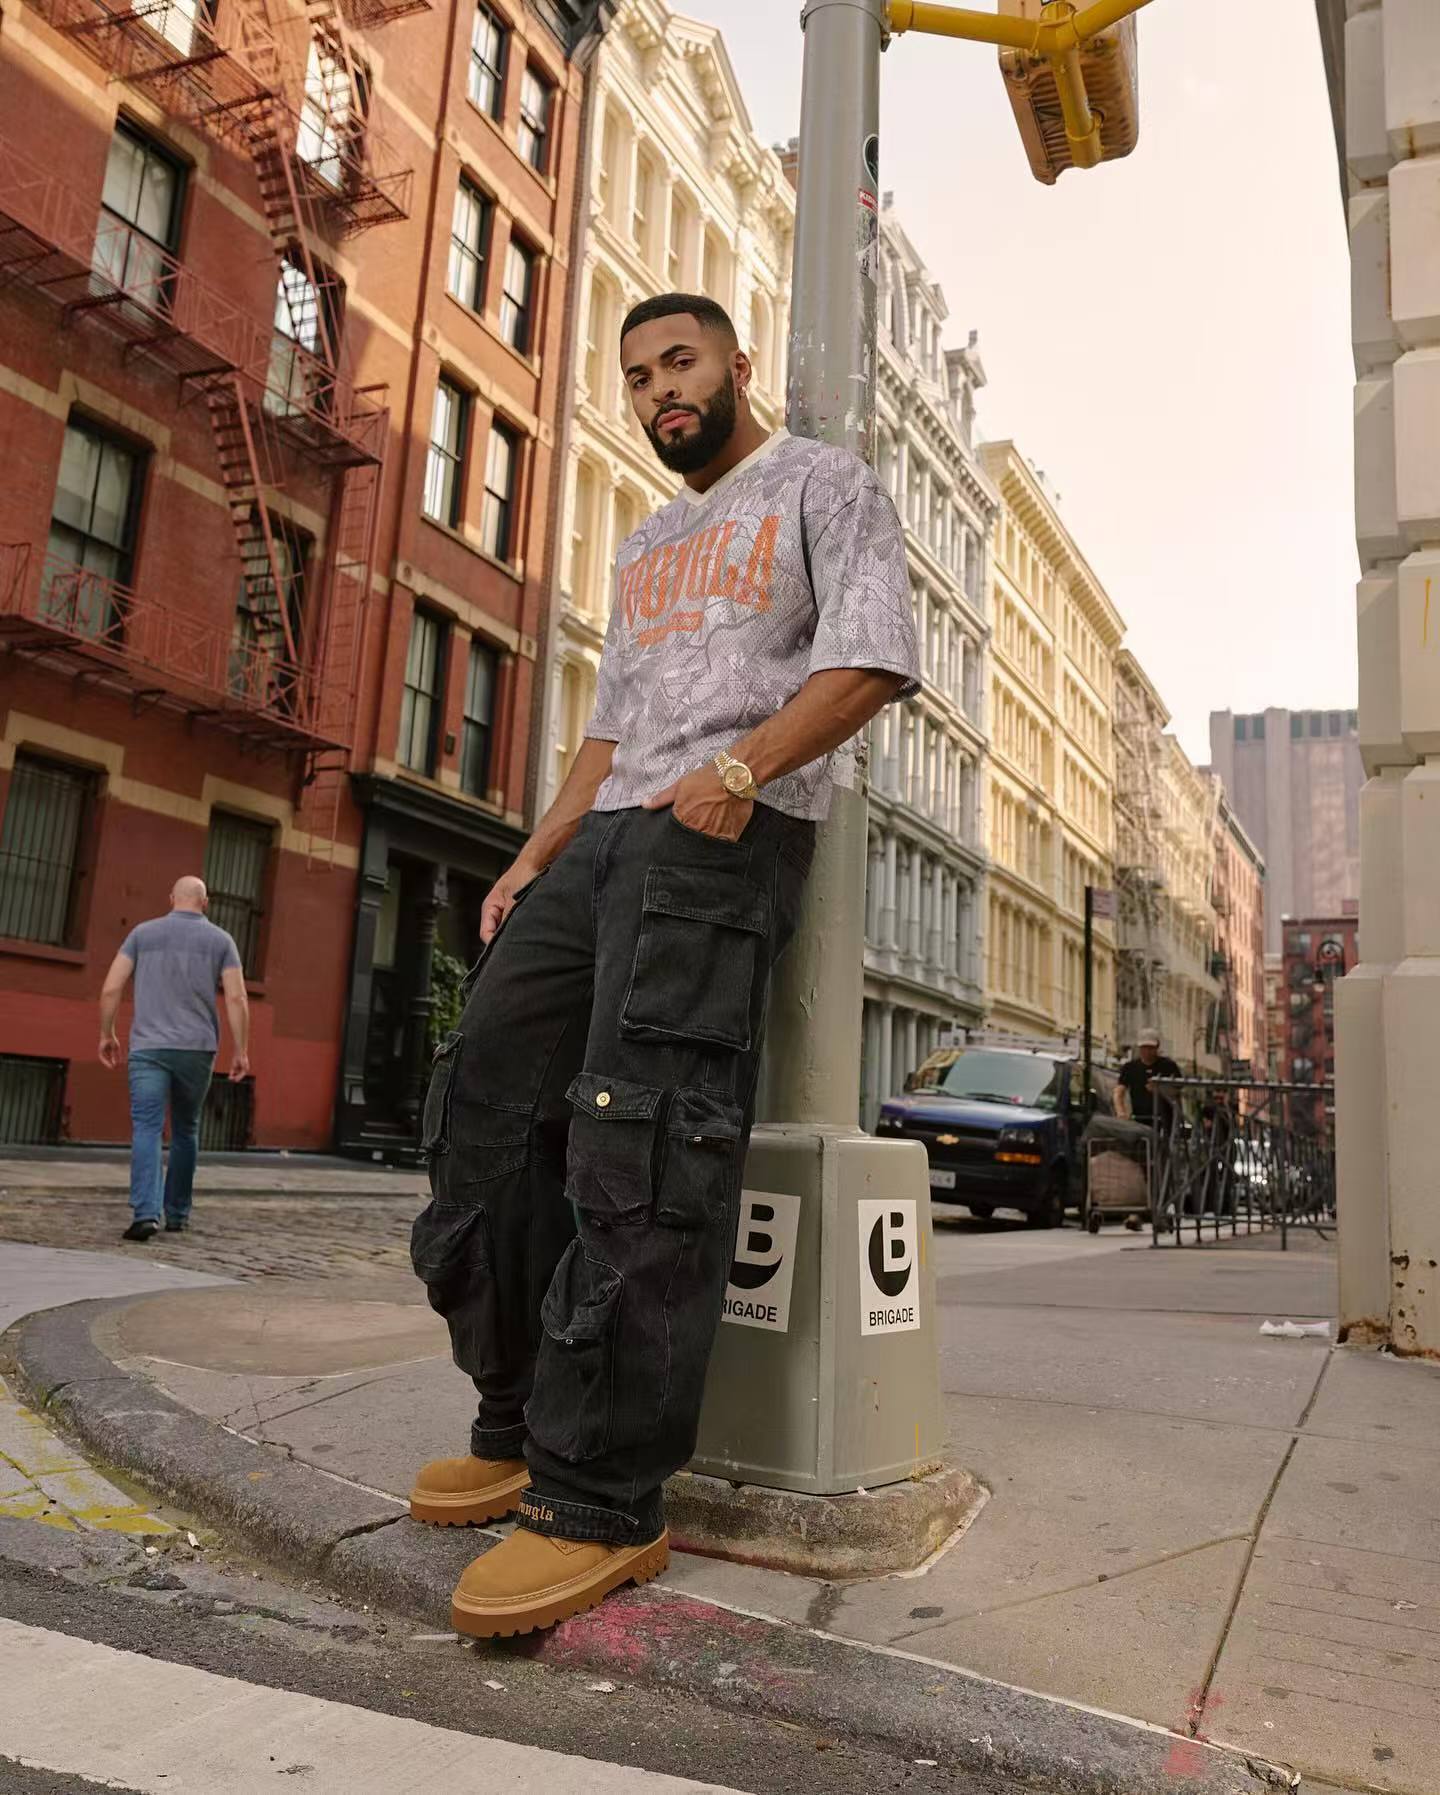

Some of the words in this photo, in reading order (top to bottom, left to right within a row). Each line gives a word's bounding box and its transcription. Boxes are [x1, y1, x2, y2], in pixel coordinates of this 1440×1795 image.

[721, 1299, 778, 1323] RIGADE
[869, 1307, 914, 1327] BRIGADE
[519, 1502, 554, 1522] ungla
